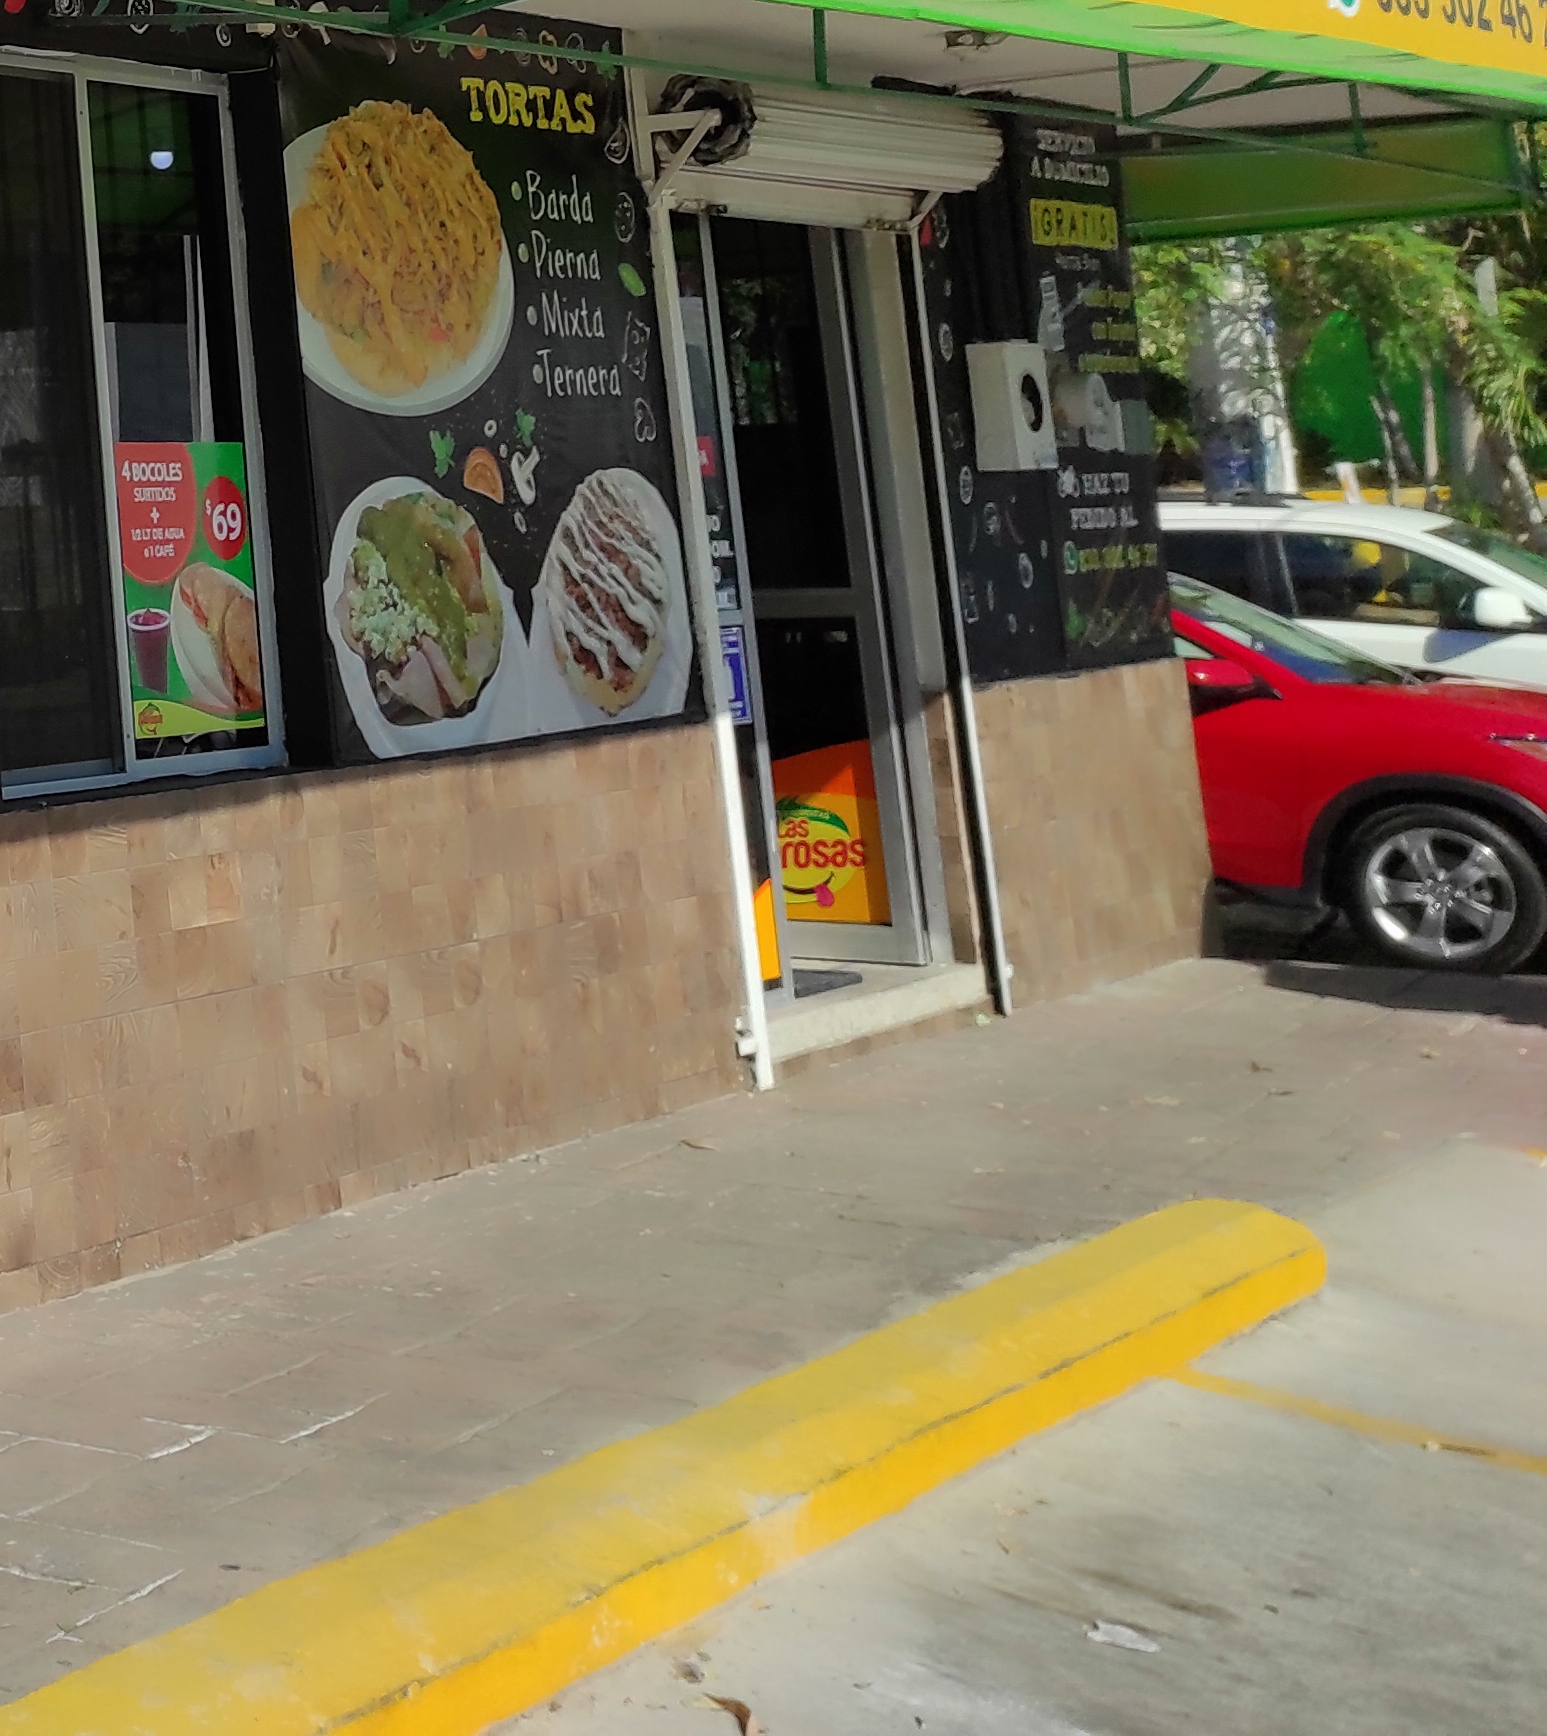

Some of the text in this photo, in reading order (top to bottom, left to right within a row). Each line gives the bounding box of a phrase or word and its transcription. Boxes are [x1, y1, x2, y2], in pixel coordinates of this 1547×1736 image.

[461, 76, 595, 135] TORTAS
[526, 170, 594, 224] Barda
[532, 231, 602, 282] Pierna
[541, 293, 606, 340] Mixta
[539, 349, 622, 400] Ternera
[121, 460, 131, 482] 4
[782, 839, 865, 869] rosas
